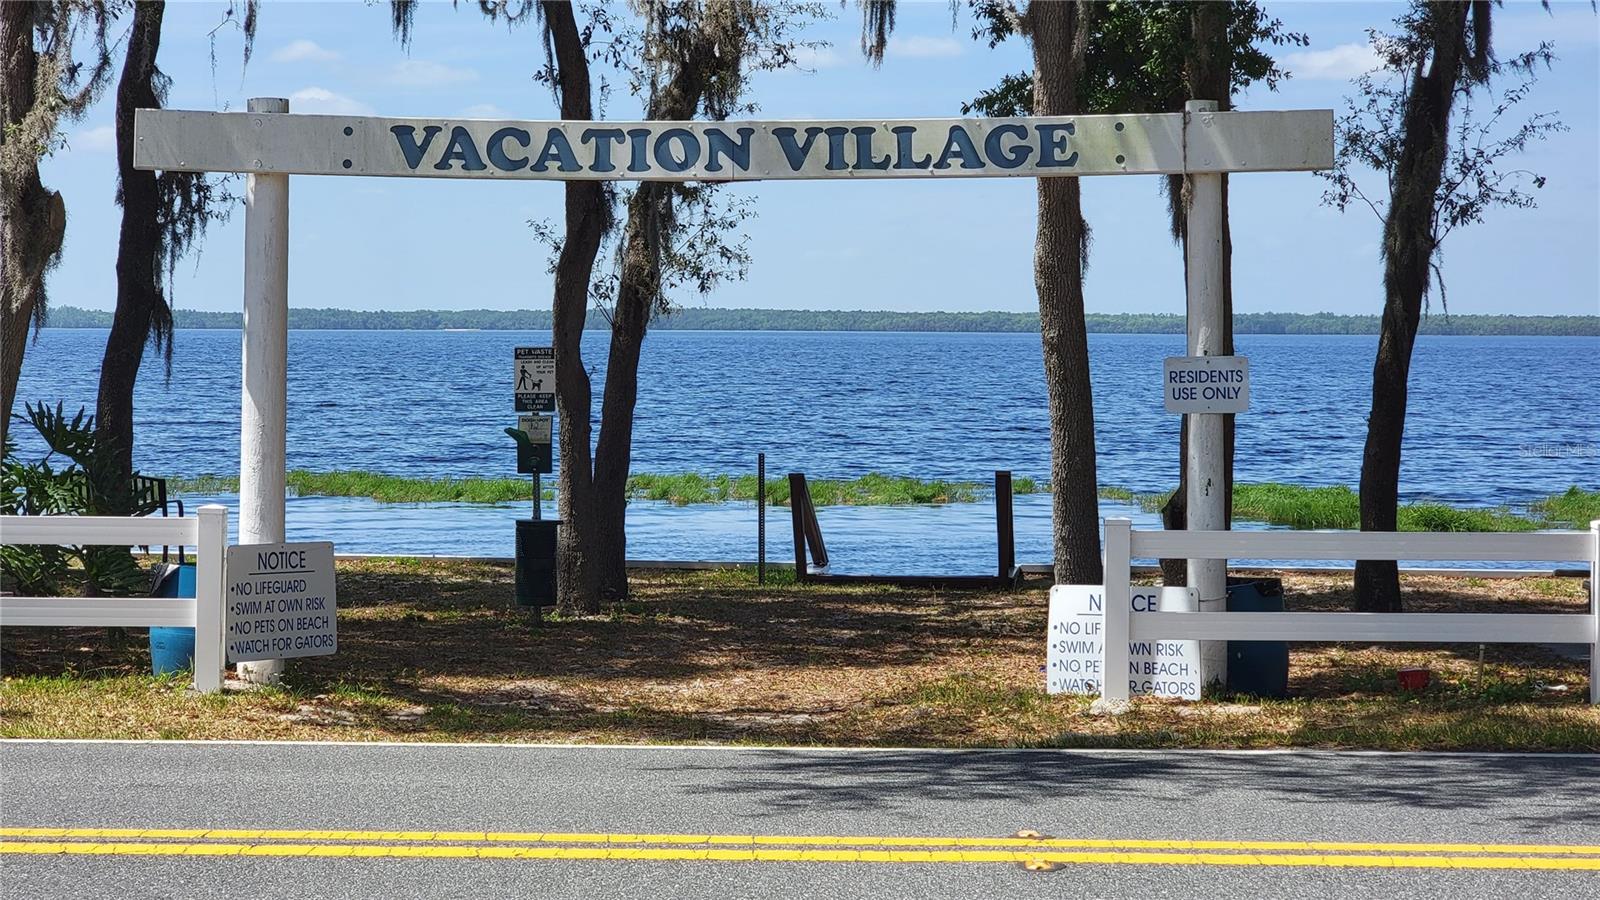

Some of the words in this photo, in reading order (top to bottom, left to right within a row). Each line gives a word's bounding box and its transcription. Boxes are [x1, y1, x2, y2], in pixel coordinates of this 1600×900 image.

[390, 125, 755, 172] VACATION
[772, 123, 1079, 171] VILLAGE
[1169, 370, 1243, 383] RESIDENTS
[1172, 387, 1197, 400] USE
[1202, 386, 1241, 400] ONLY
[258, 551, 306, 570] NOTICE
[236, 582, 252, 596] NO
[255, 580, 307, 595] LIFEGUARD
[235, 601, 262, 616] SWIM
[264, 600, 275, 613] AT
[278, 599, 302, 613] OWN
[306, 597, 326, 611] RISK
[1089, 594, 1157, 612] NCE
[235, 621, 251, 635] NO
[255, 619, 275, 633] PETS
[278, 618, 294, 632] ON
[297, 616, 329, 630] BEACH
[1059, 621, 1080, 635] NO
[234, 639, 269, 654] WATCH
[273, 637, 292, 651] FOR
[295, 634, 334, 650] GATORS
[1059, 640, 1094, 654] SWIM
[1129, 642, 1151, 656] WN
[1156, 643, 1184, 657] RISK
[1059, 659, 1081, 673] NO
[1130, 662, 1139, 674] N
[1144, 662, 1189, 676] BEACH
[1141, 680, 1196, 696] GATORS
